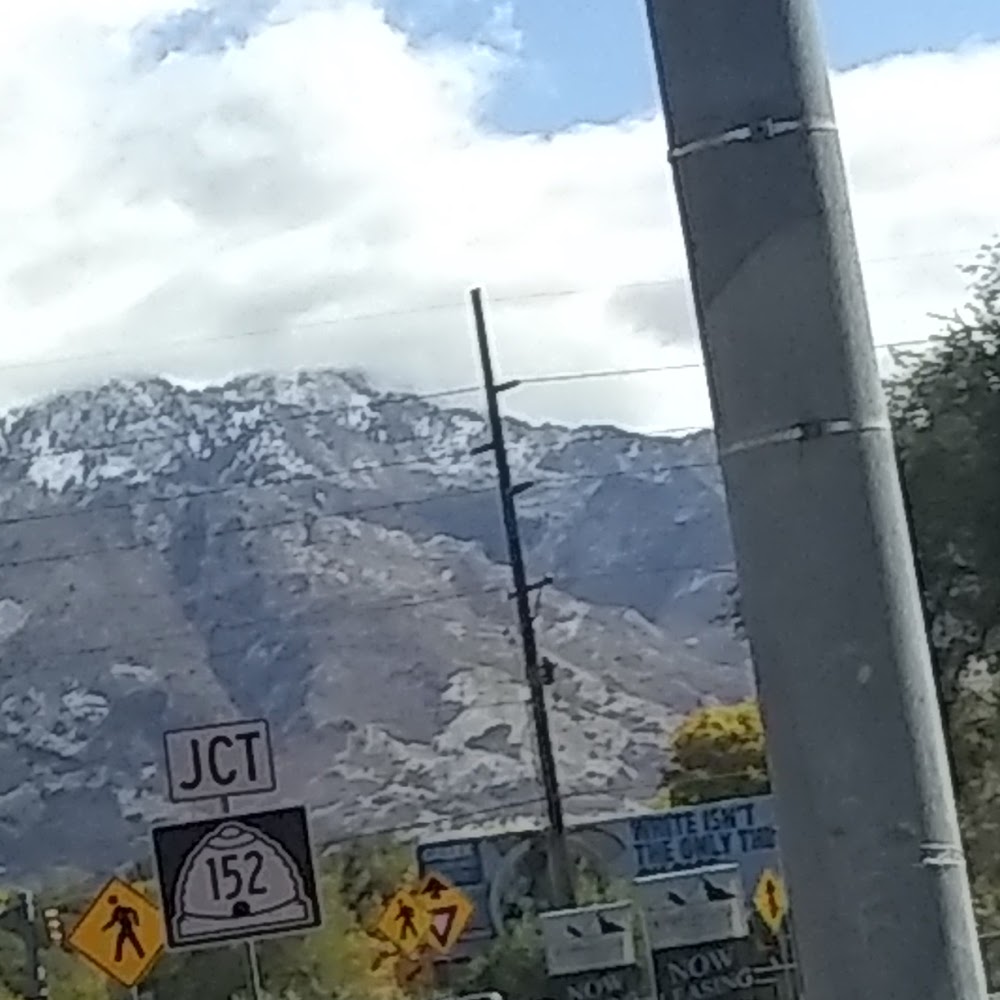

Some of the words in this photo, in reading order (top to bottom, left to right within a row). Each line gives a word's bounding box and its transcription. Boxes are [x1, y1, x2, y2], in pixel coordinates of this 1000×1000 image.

[179, 731, 261, 790] JCT
[205, 850, 268, 900] 152
[667, 948, 734, 985] NOW
